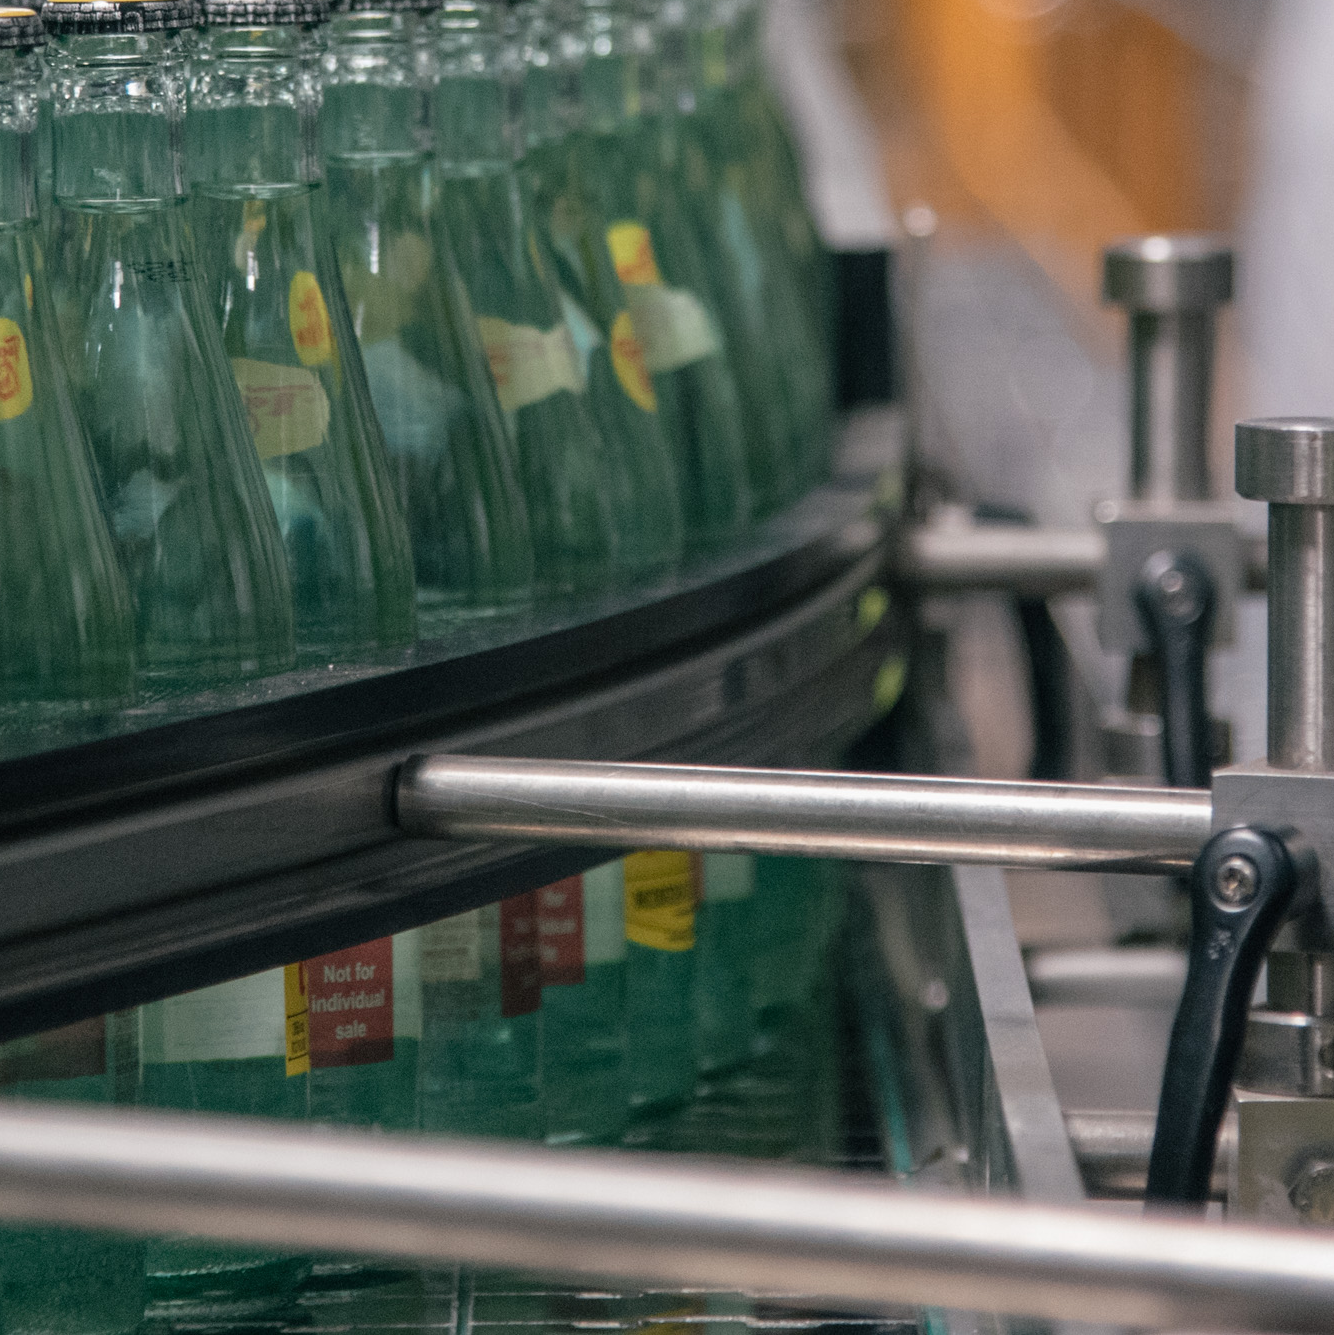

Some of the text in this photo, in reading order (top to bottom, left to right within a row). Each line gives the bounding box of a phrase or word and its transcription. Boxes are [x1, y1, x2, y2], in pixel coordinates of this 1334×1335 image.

[323, 962, 377, 984] Not for
[311, 989, 386, 1014] individual
[335, 1020, 367, 1040] sale
